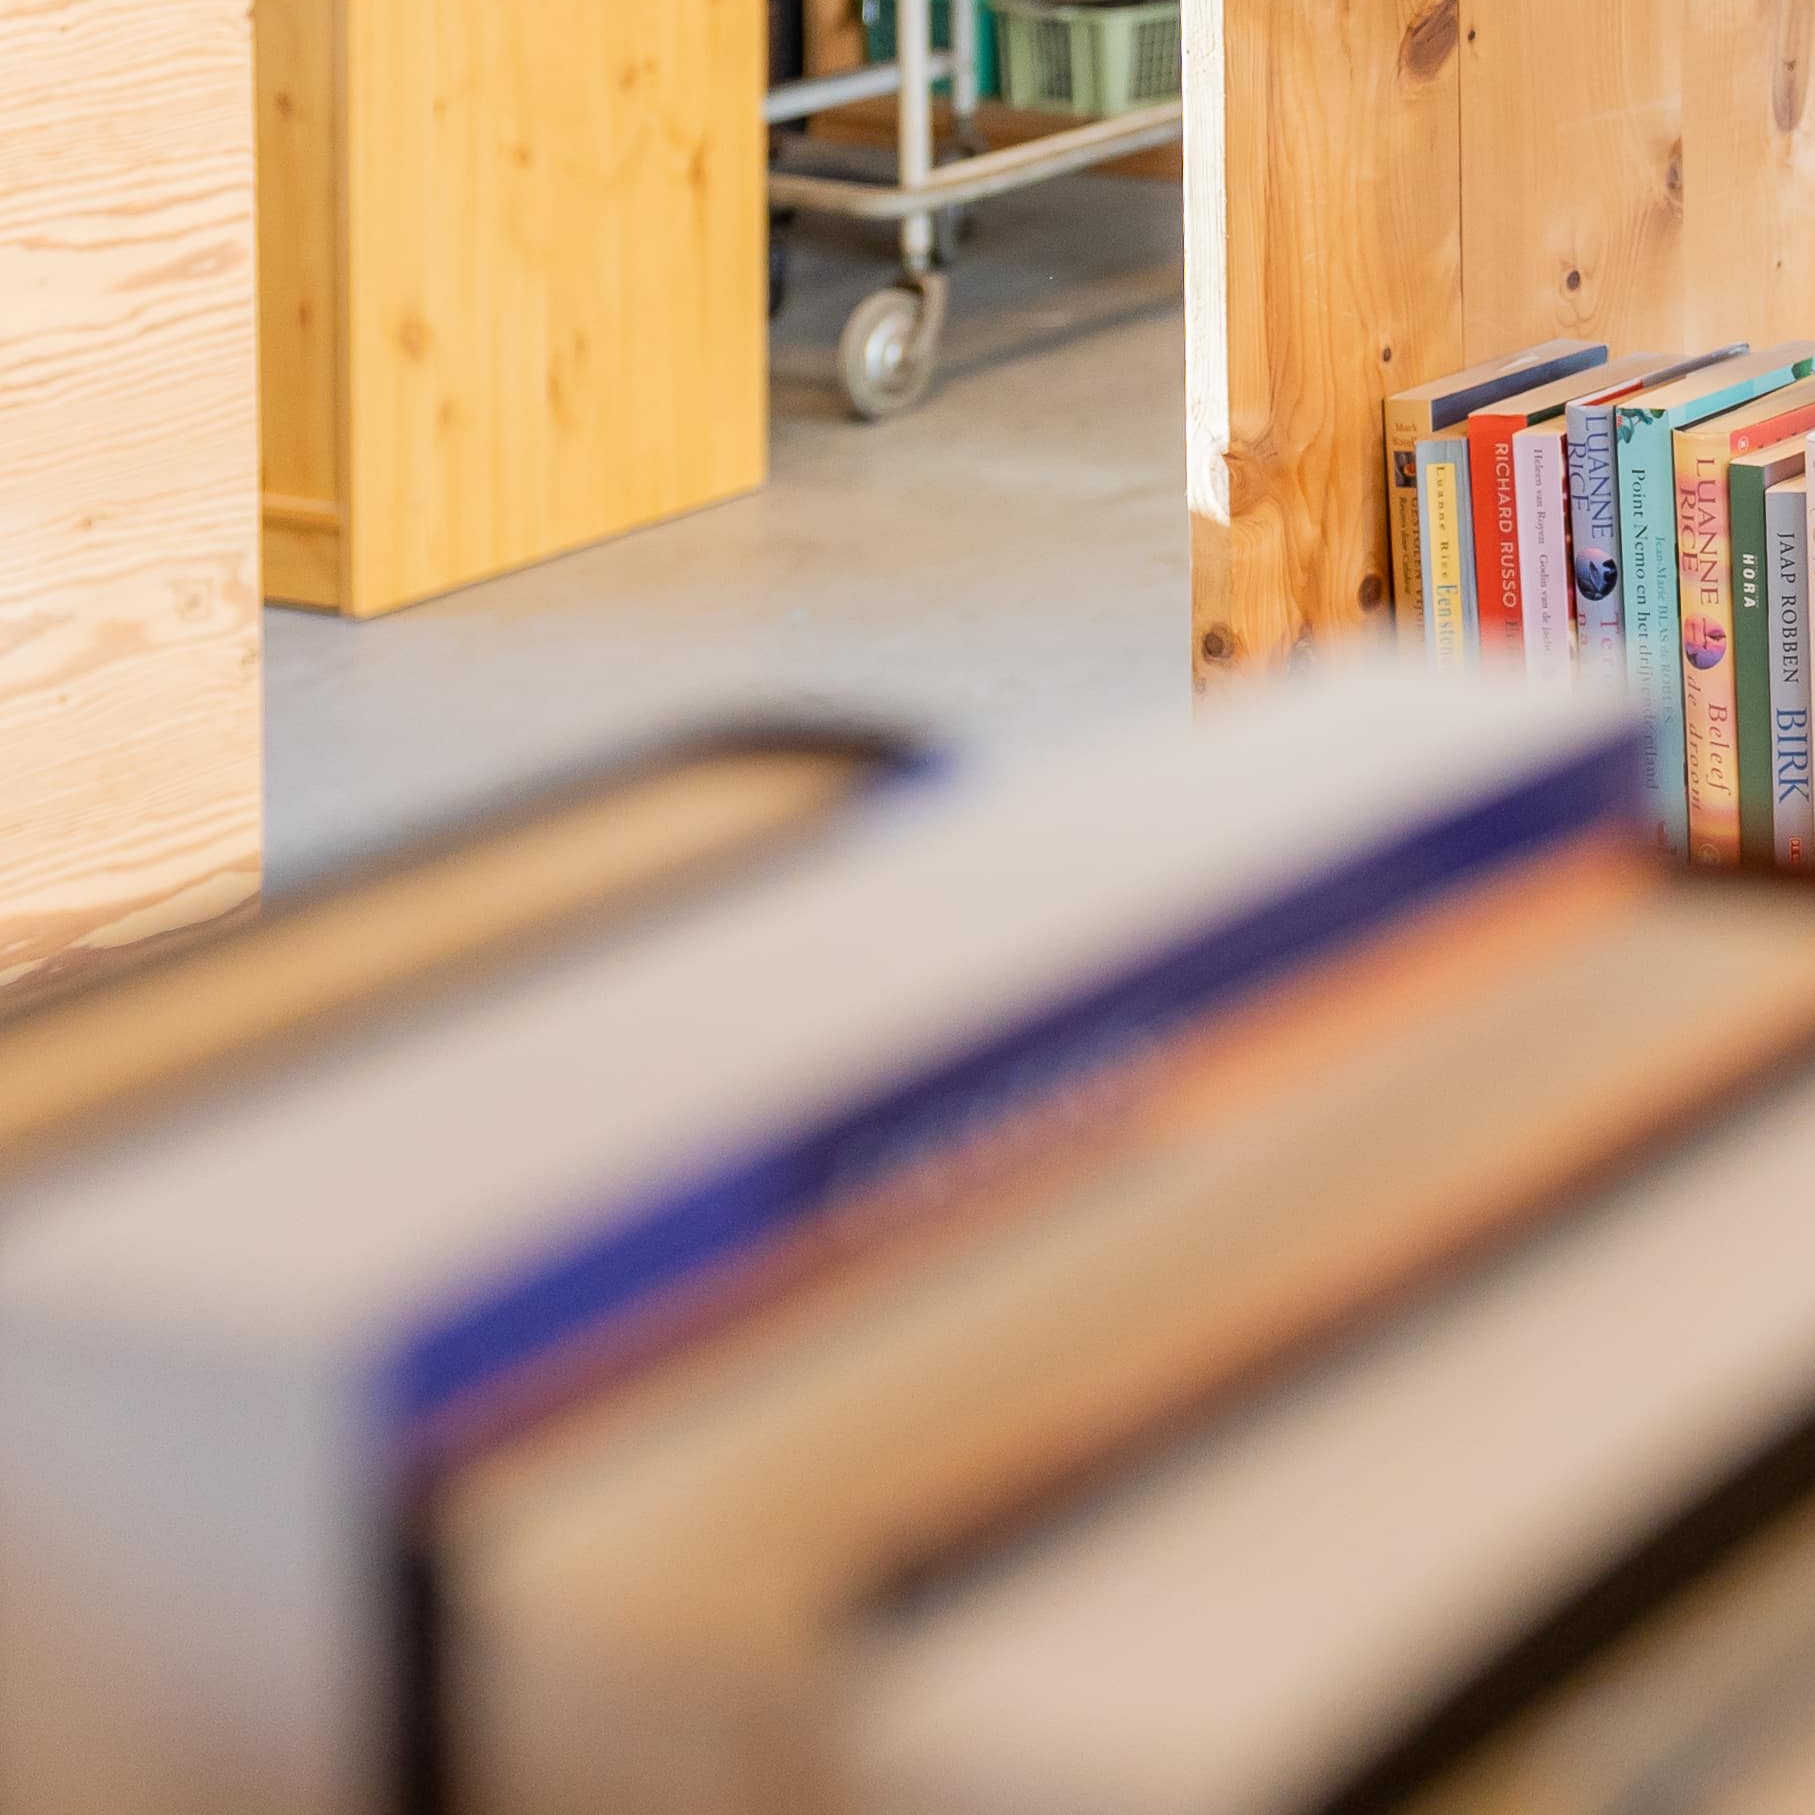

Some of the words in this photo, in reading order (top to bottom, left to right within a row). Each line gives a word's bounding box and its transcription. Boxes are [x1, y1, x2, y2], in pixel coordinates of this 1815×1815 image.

[1495, 443, 1513, 533] RICHARD
[1499, 542, 1517, 608] RUSSO
[1777, 532, 1797, 585] JAAP
[1782, 595, 1799, 684] ROBBEN
[1777, 709, 1809, 804] BIRK
